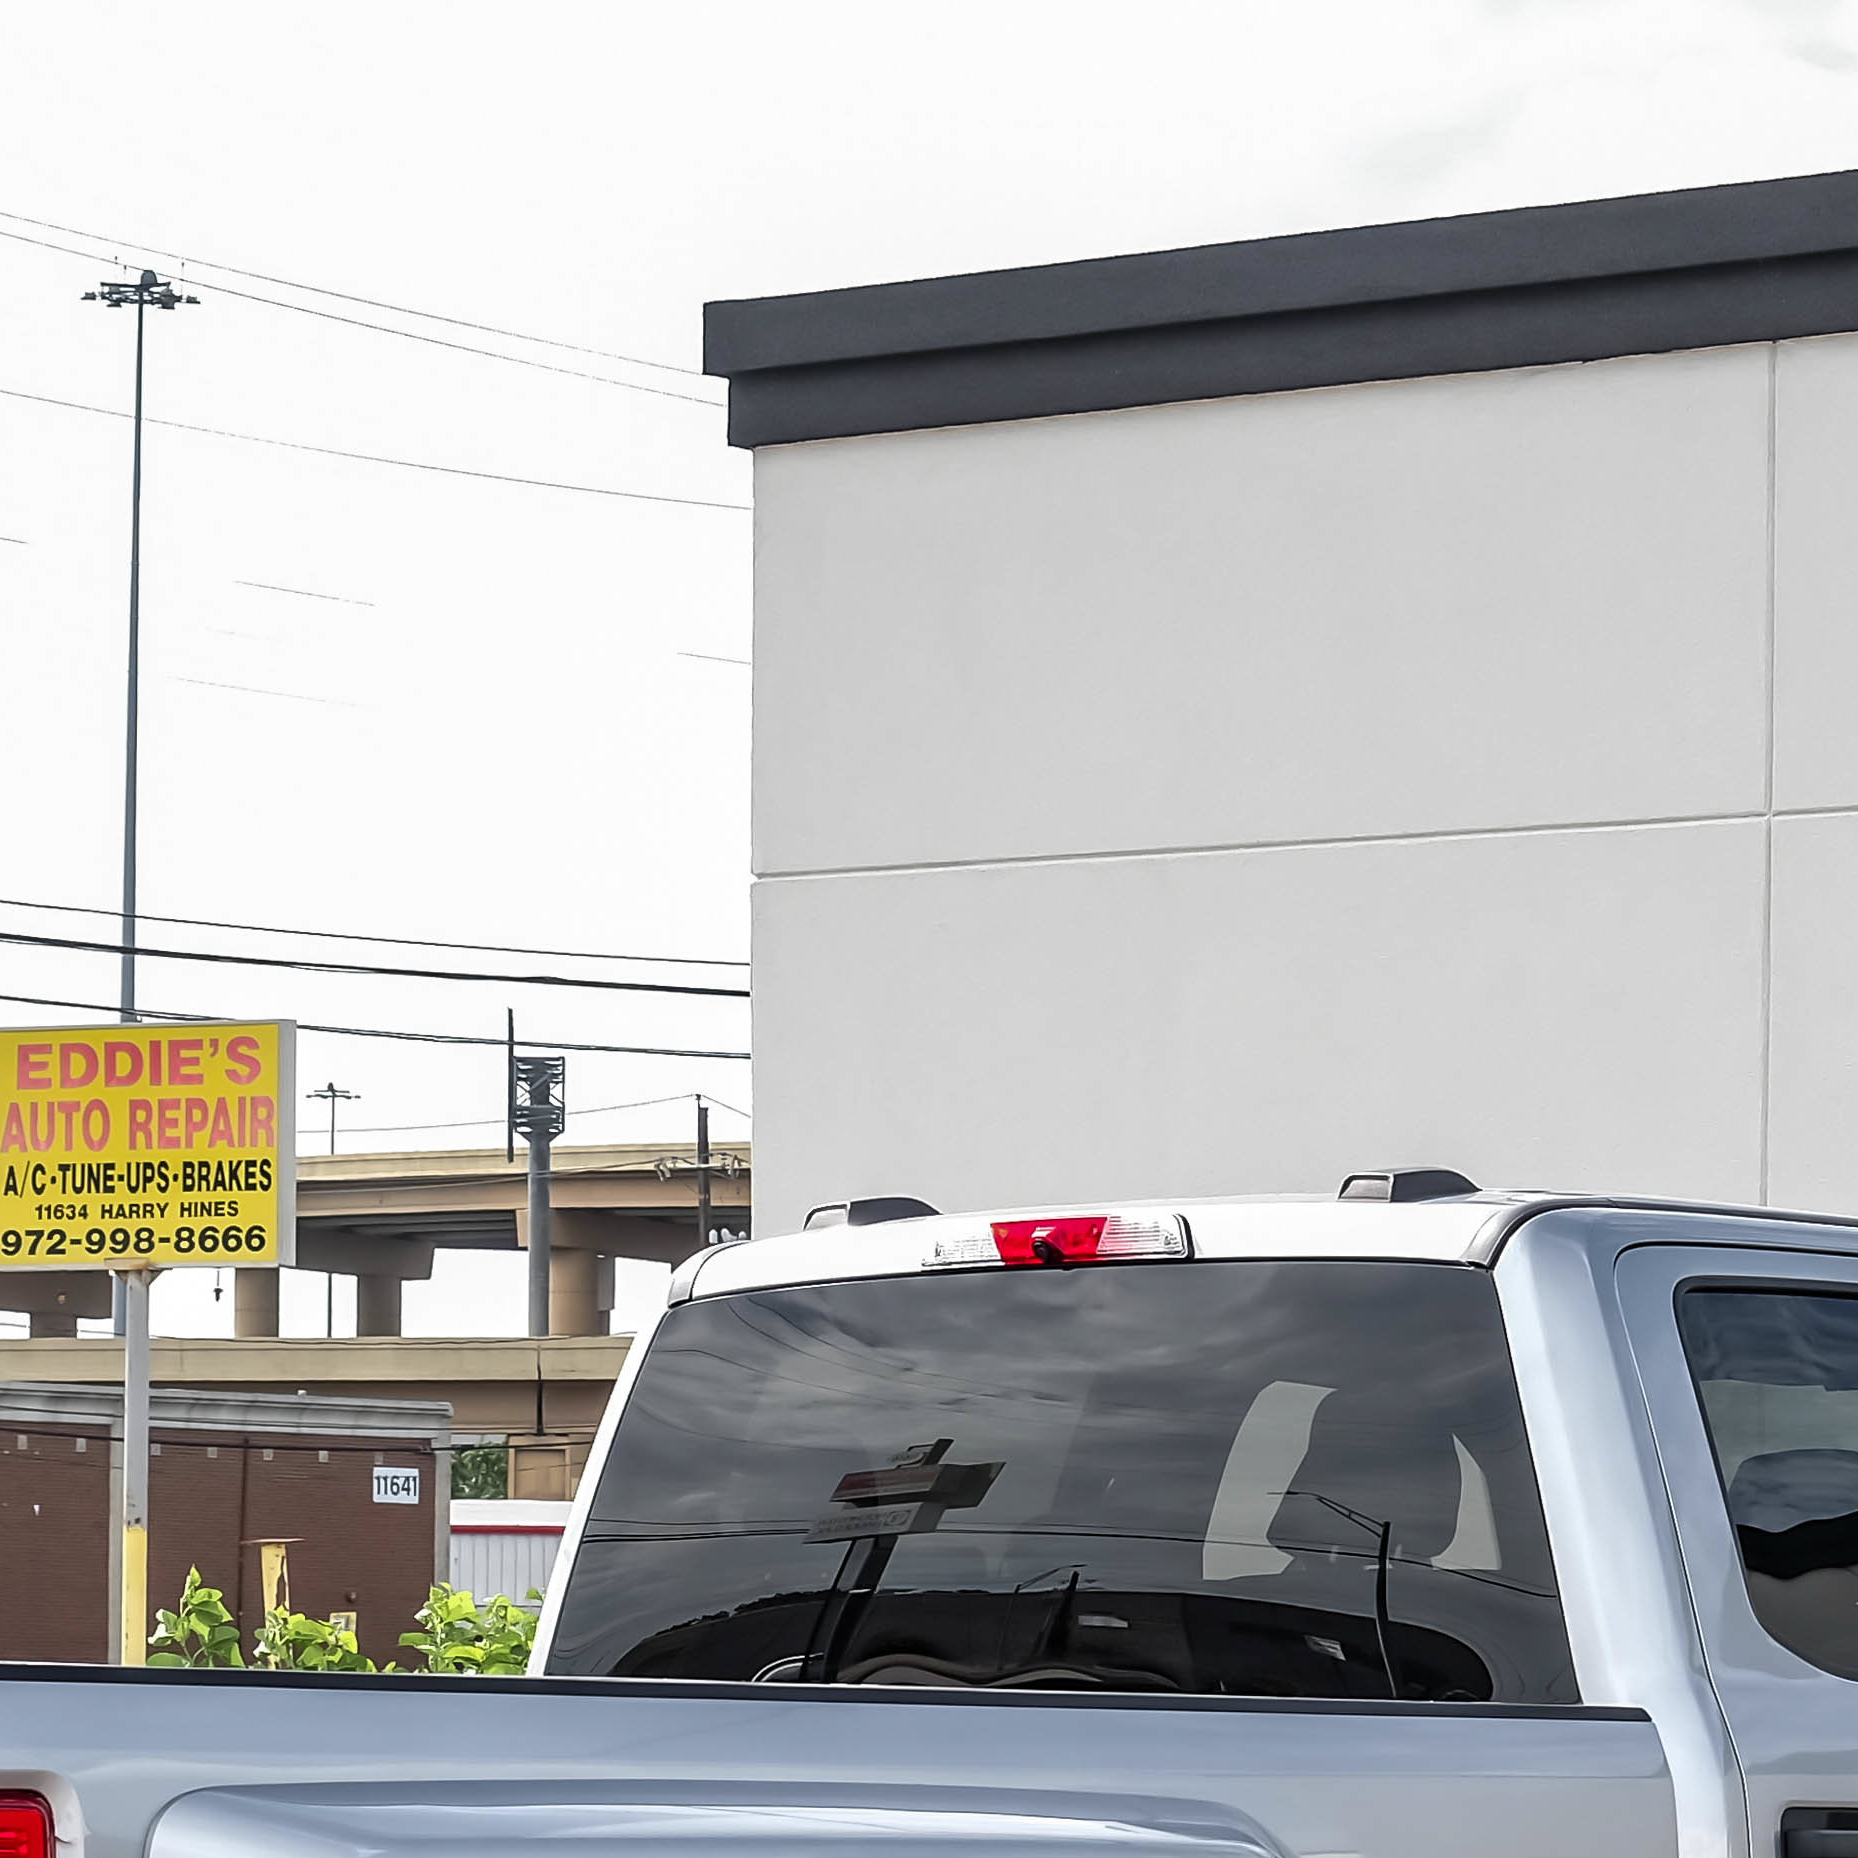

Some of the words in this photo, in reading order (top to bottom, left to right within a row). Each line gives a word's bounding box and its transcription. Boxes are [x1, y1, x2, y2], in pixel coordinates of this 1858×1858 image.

[16, 1036, 262, 1090] EDDIE'S
[0, 1098, 111, 1153] AUTO
[128, 1096, 275, 1151] REPAIR
[35, 1203, 89, 1220] 11634
[100, 1202, 169, 1219] HARRY
[180, 1200, 239, 1218] HINES
[0, 1225, 267, 1256] 972-998-8666
[374, 1475, 417, 1496] 11641
